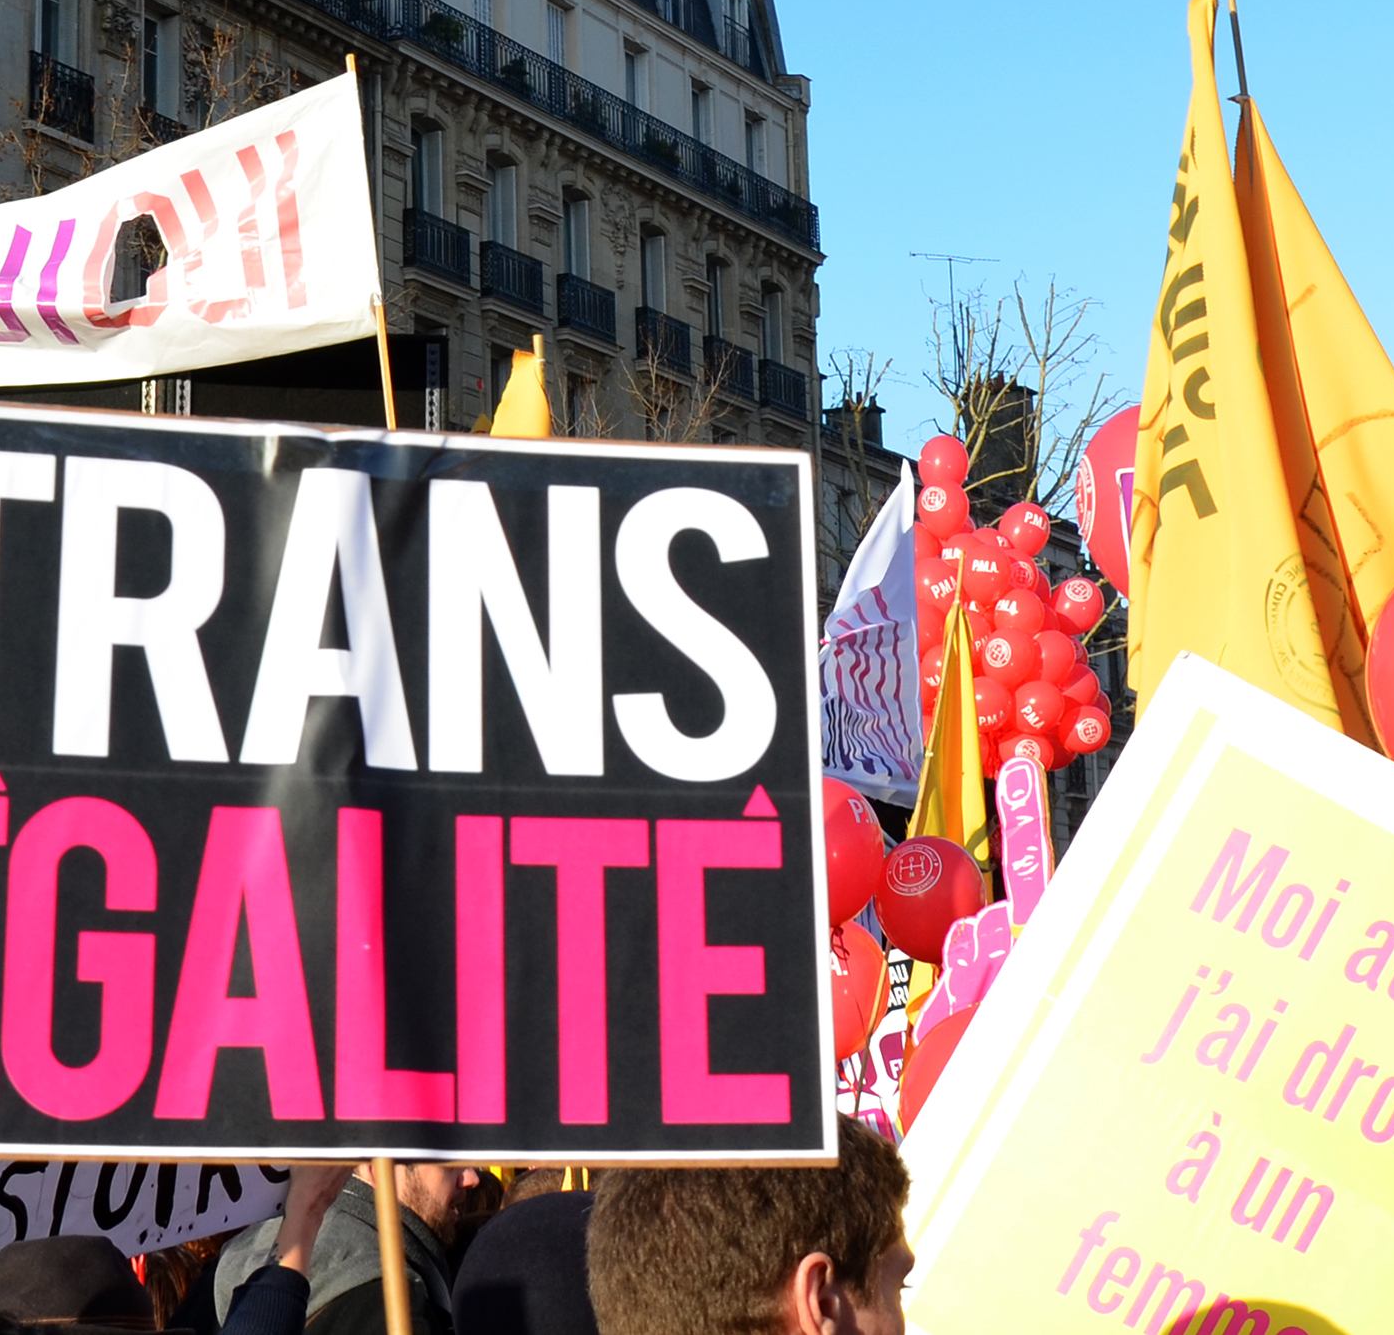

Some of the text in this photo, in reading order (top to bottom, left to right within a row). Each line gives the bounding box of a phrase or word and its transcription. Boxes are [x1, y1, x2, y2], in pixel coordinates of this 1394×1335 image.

[1189, 827, 1352, 962] Moi
[1139, 965, 1289, 1083] j'ai
[1164, 1111, 1336, 1254] à un
[1054, 1210, 1312, 1335] femm
